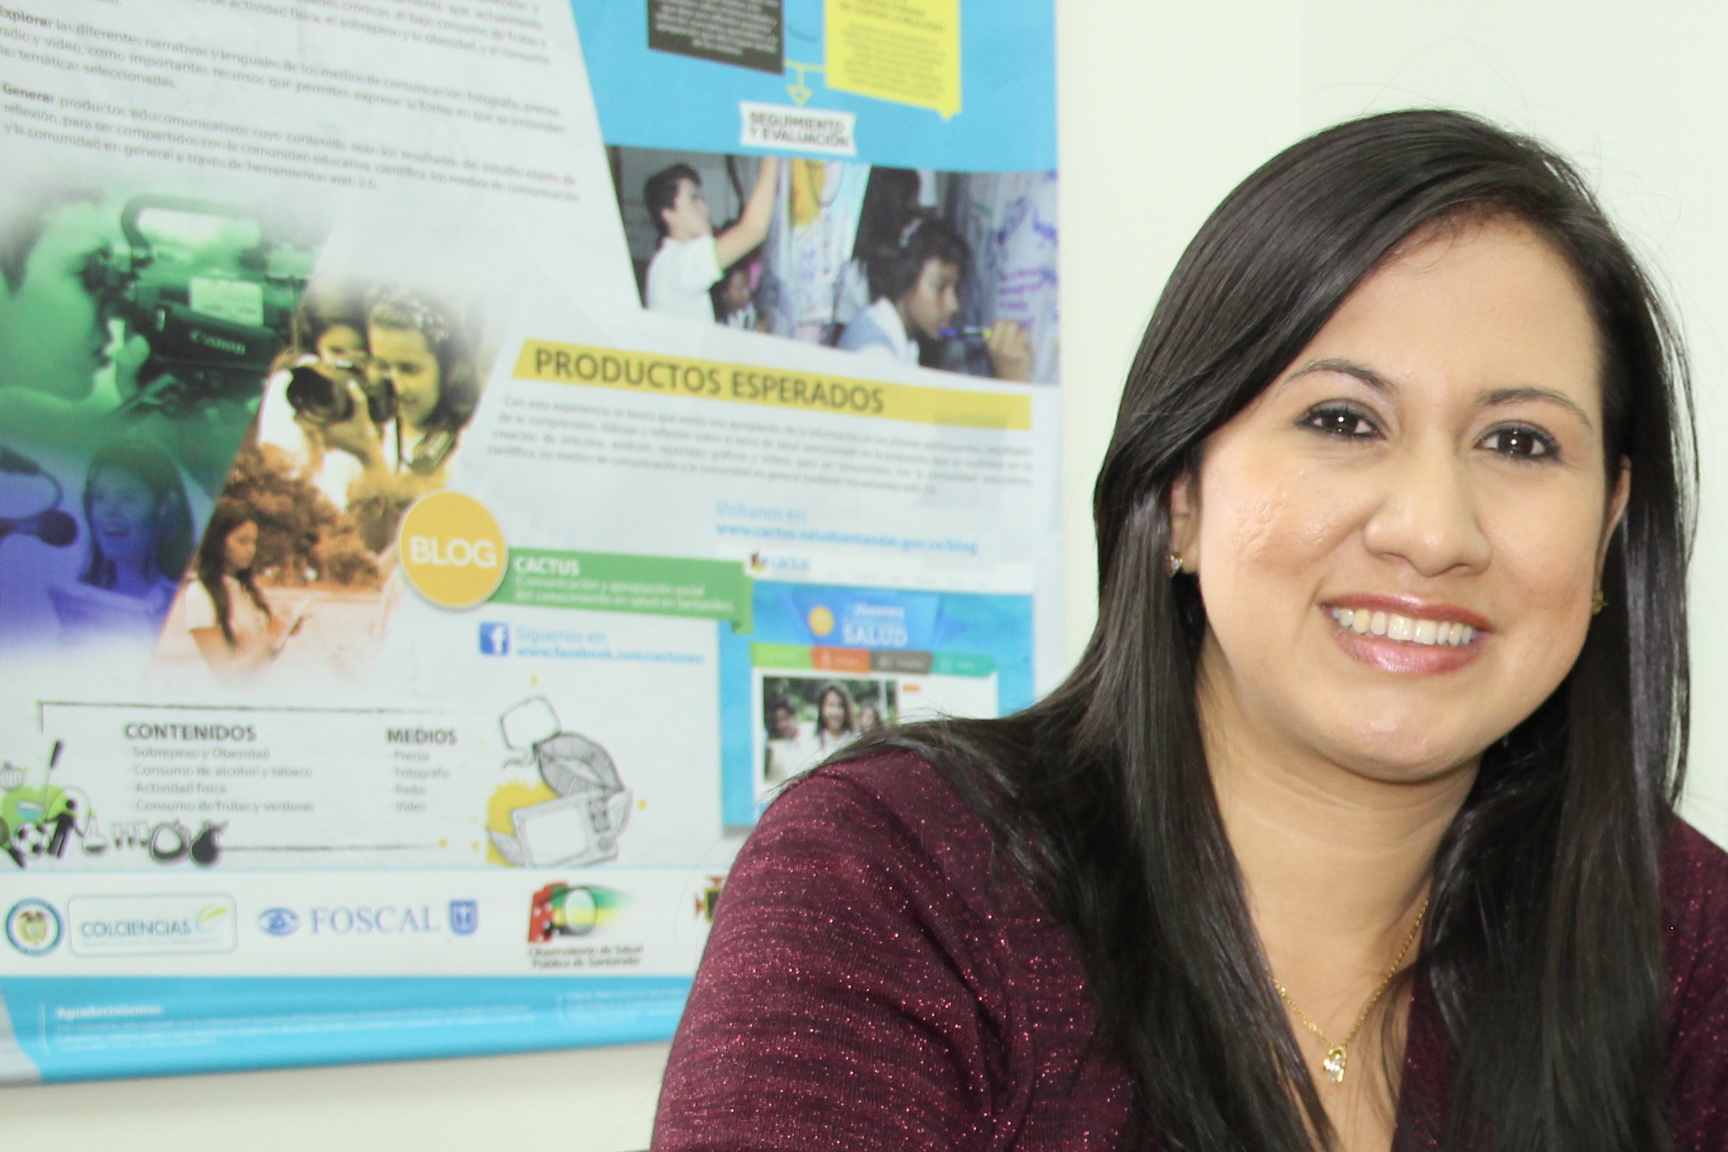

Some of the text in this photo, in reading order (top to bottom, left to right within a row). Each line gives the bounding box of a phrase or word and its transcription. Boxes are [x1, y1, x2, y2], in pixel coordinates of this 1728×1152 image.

[751, 112, 845, 133] SEGUIMIENTO
[764, 125, 849, 148] EVALUACIÓN
[190, 332, 246, 356] Canon
[535, 347, 885, 414] PRODUCTOS ESPERADOS
[410, 536, 497, 569] BLOG
[513, 556, 581, 576] CACTUS
[842, 622, 908, 649] SALUD
[125, 724, 257, 742] CONTENIDOS
[387, 728, 458, 745] MEDIOS
[134, 746, 199, 762] Sobrepeso
[213, 746, 270, 761] Obesidad
[134, 764, 194, 778] Consumo
[213, 764, 258, 778] alcohol
[272, 765, 312, 779] tabaco
[136, 800, 196, 813] Consumo
[215, 800, 250, 813] frutas
[264, 802, 315, 814] verduras
[81, 919, 192, 938] COLCIENCIAS
[311, 907, 442, 935] FOSCAL
